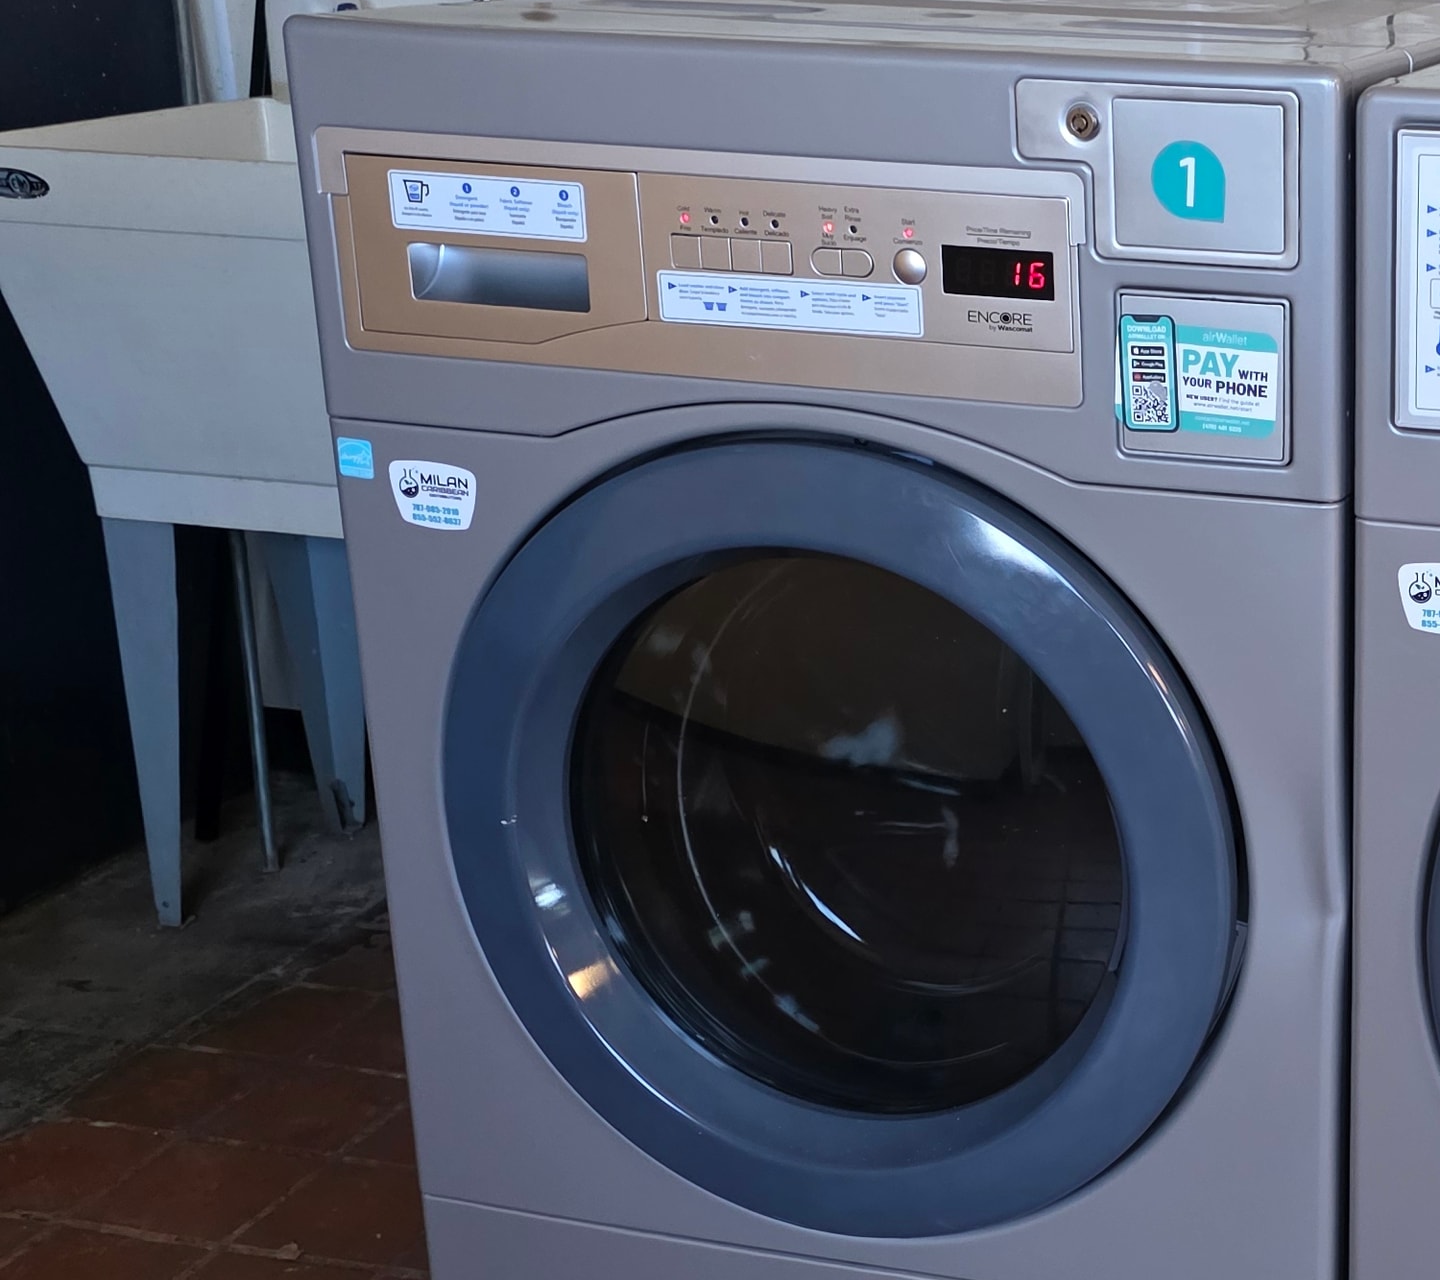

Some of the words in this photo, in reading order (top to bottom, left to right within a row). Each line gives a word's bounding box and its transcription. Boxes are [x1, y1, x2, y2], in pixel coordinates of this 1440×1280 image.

[1179, 156, 1196, 208] 1
[1014, 261, 1046, 289] 16
[967, 310, 1033, 326] ENCORE
[998, 324, 1033, 333] Wascomat
[1202, 331, 1248, 346] airWallet
[1182, 348, 1240, 378] PAY
[1238, 368, 1268, 382] WITH
[1182, 375, 1212, 389] YOUR
[1215, 380, 1268, 398] PHONE
[420, 472, 469, 489] MILAN
